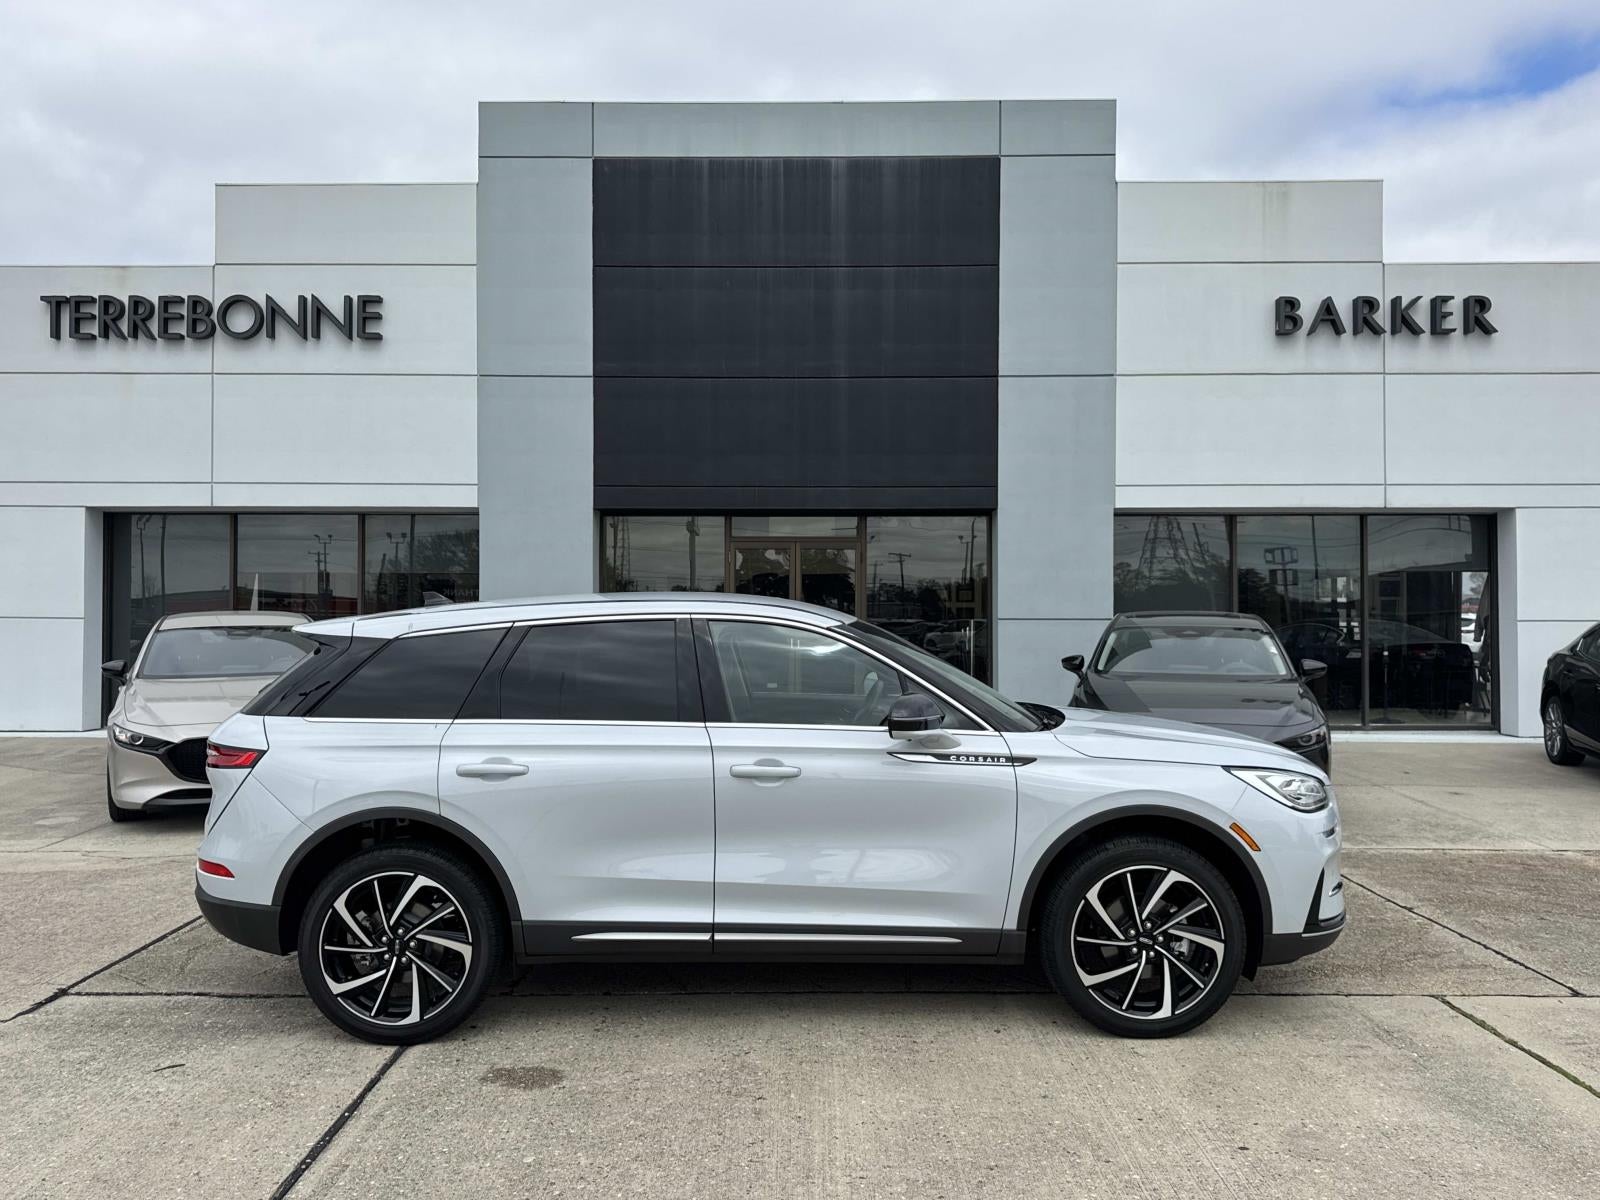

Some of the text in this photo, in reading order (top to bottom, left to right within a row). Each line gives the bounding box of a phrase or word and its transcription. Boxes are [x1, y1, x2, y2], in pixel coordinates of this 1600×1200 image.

[40, 293, 384, 341] TERREBONNE
[1275, 295, 1499, 336] BARKER
[950, 755, 1006, 763] CORSAIR
